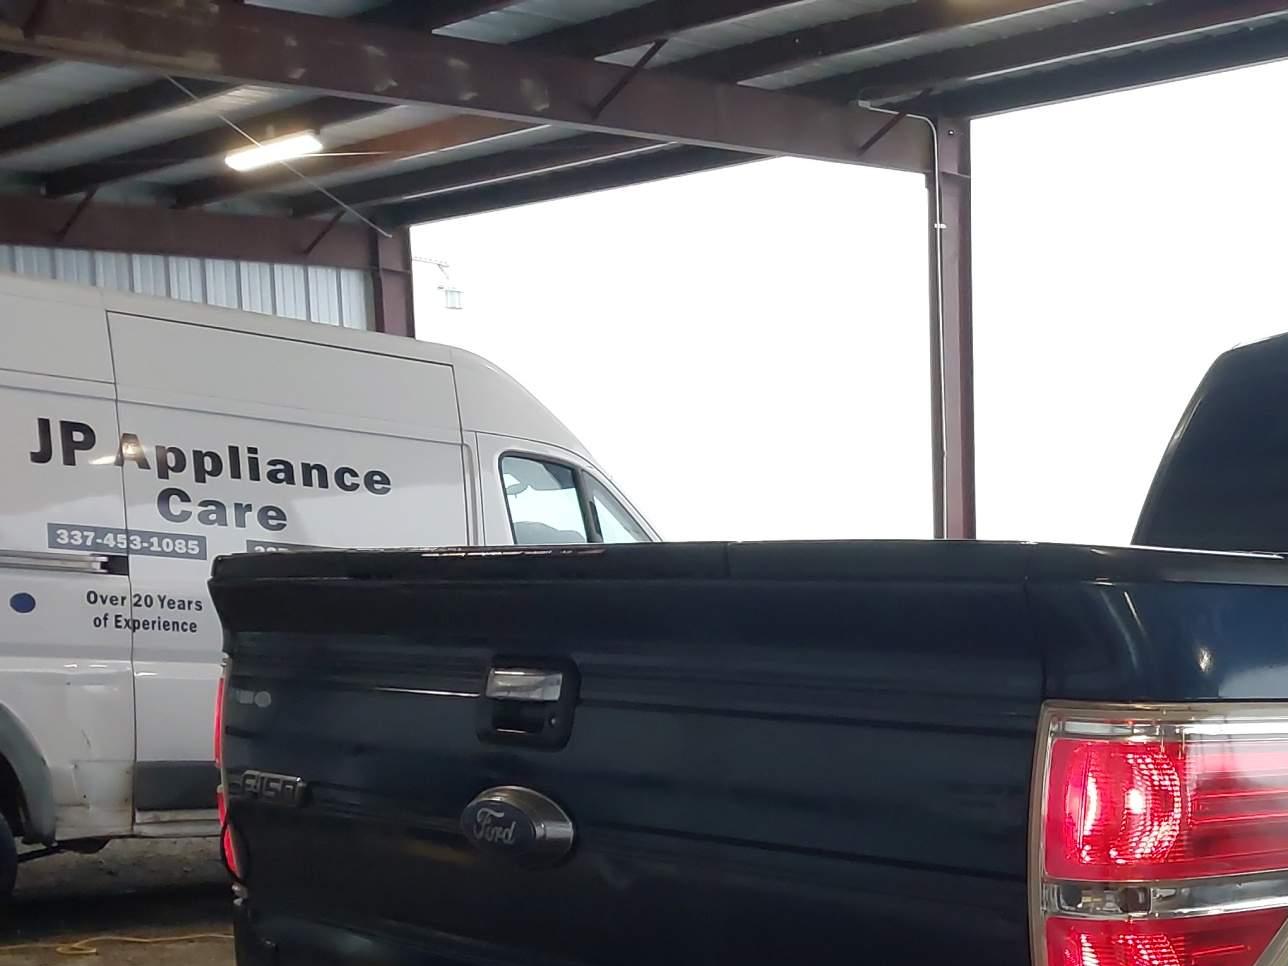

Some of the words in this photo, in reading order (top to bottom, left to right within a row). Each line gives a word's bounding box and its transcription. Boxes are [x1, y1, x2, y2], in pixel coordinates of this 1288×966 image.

[29, 417, 97, 467] JP
[114, 432, 392, 496] Appliance
[156, 486, 289, 532] Care
[56, 528, 201, 554] 337-453-1085
[86, 590, 127, 606] Over
[133, 593, 154, 608] 20
[157, 594, 203, 611] Years
[93, 613, 109, 628] of
[114, 614, 198, 633] Experience
[473, 807, 516, 845] Ford
